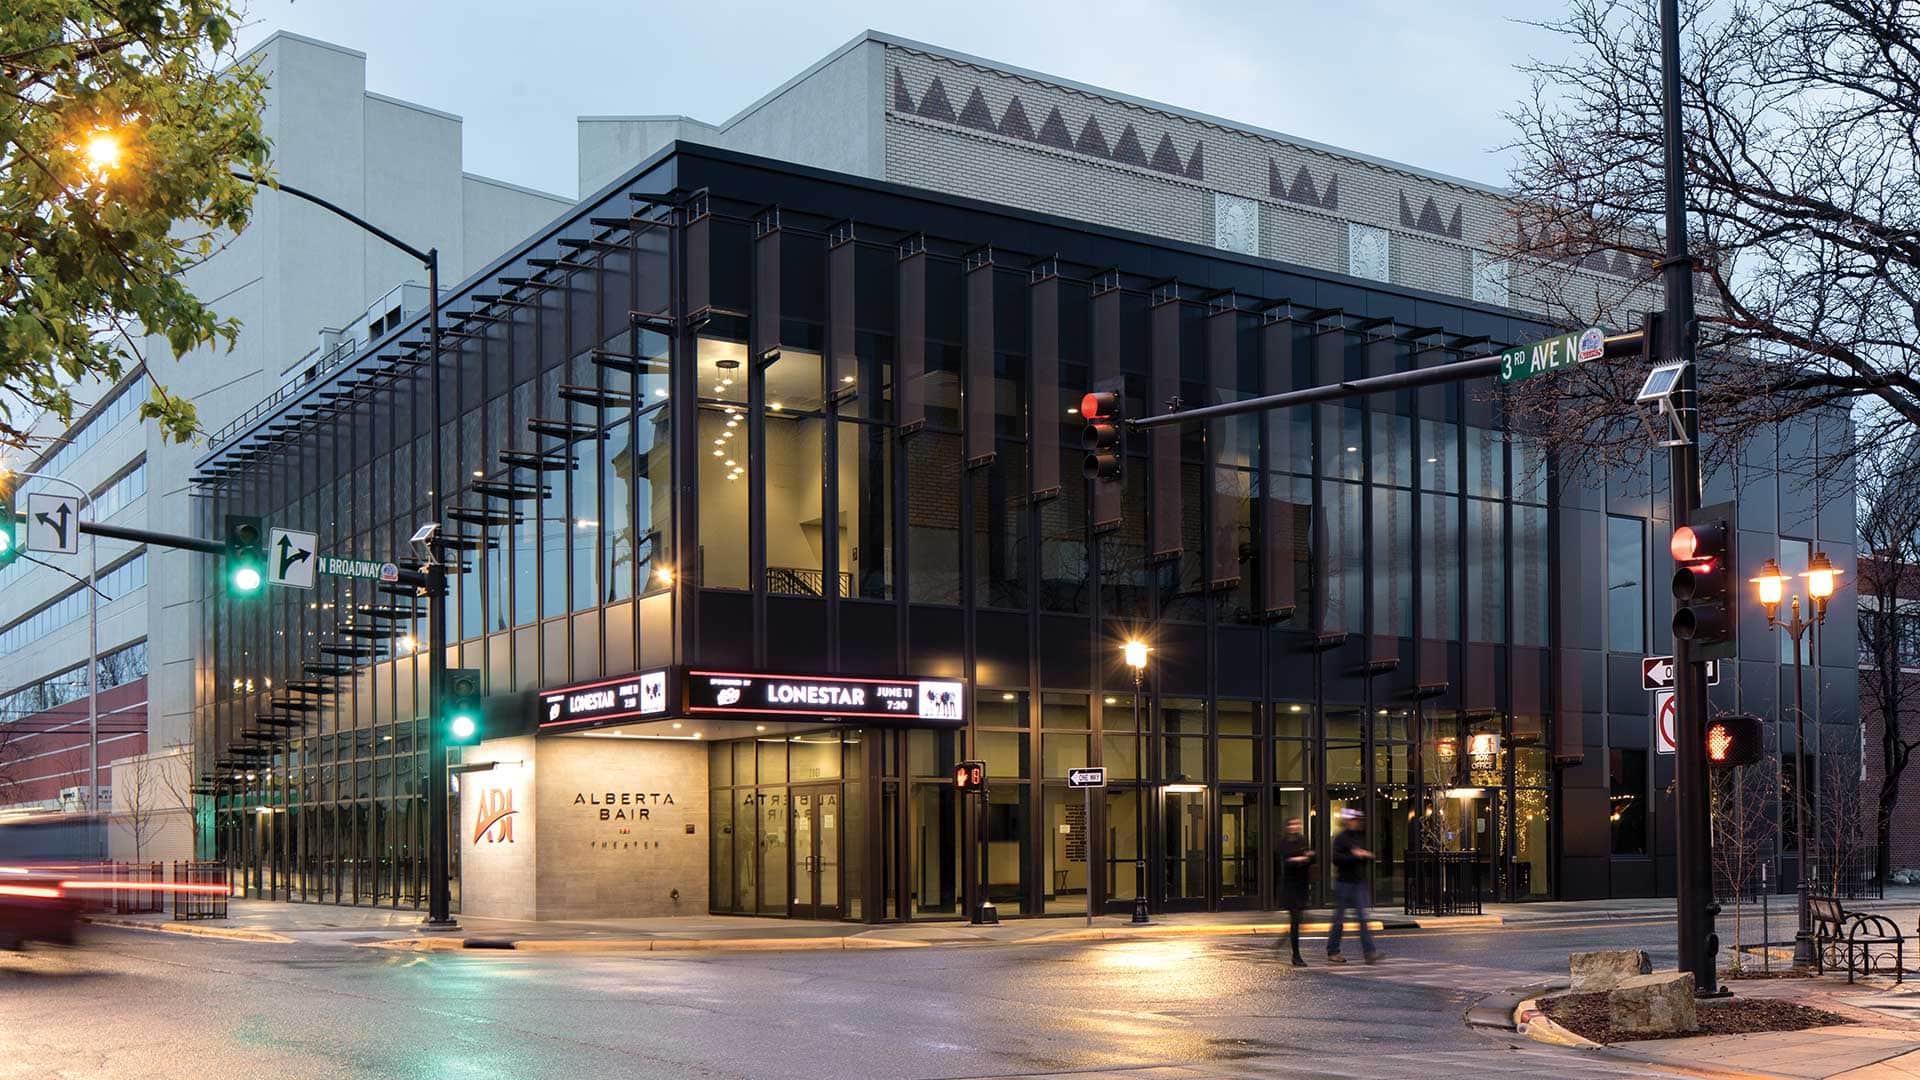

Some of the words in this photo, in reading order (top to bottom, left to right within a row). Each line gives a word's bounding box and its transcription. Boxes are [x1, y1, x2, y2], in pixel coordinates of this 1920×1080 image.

[1502, 350, 1526, 380] 3RD
[1530, 339, 1560, 373] AVE
[1566, 335, 1578, 364] N
[319, 557, 327, 573] N
[329, 558, 381, 578] BROADWAY
[767, 684, 865, 706] LONESTAR
[877, 686, 902, 698] JUNE
[903, 688, 913, 698] 11
[569, 690, 616, 713] LONESTAR
[887, 700, 908, 710] 7:30
[1471, 761, 1492, 770] OFFICE
[573, 792, 675, 805] ALBERTA
[599, 808, 650, 820] BAIR
[590, 841, 659, 850] THEATER
